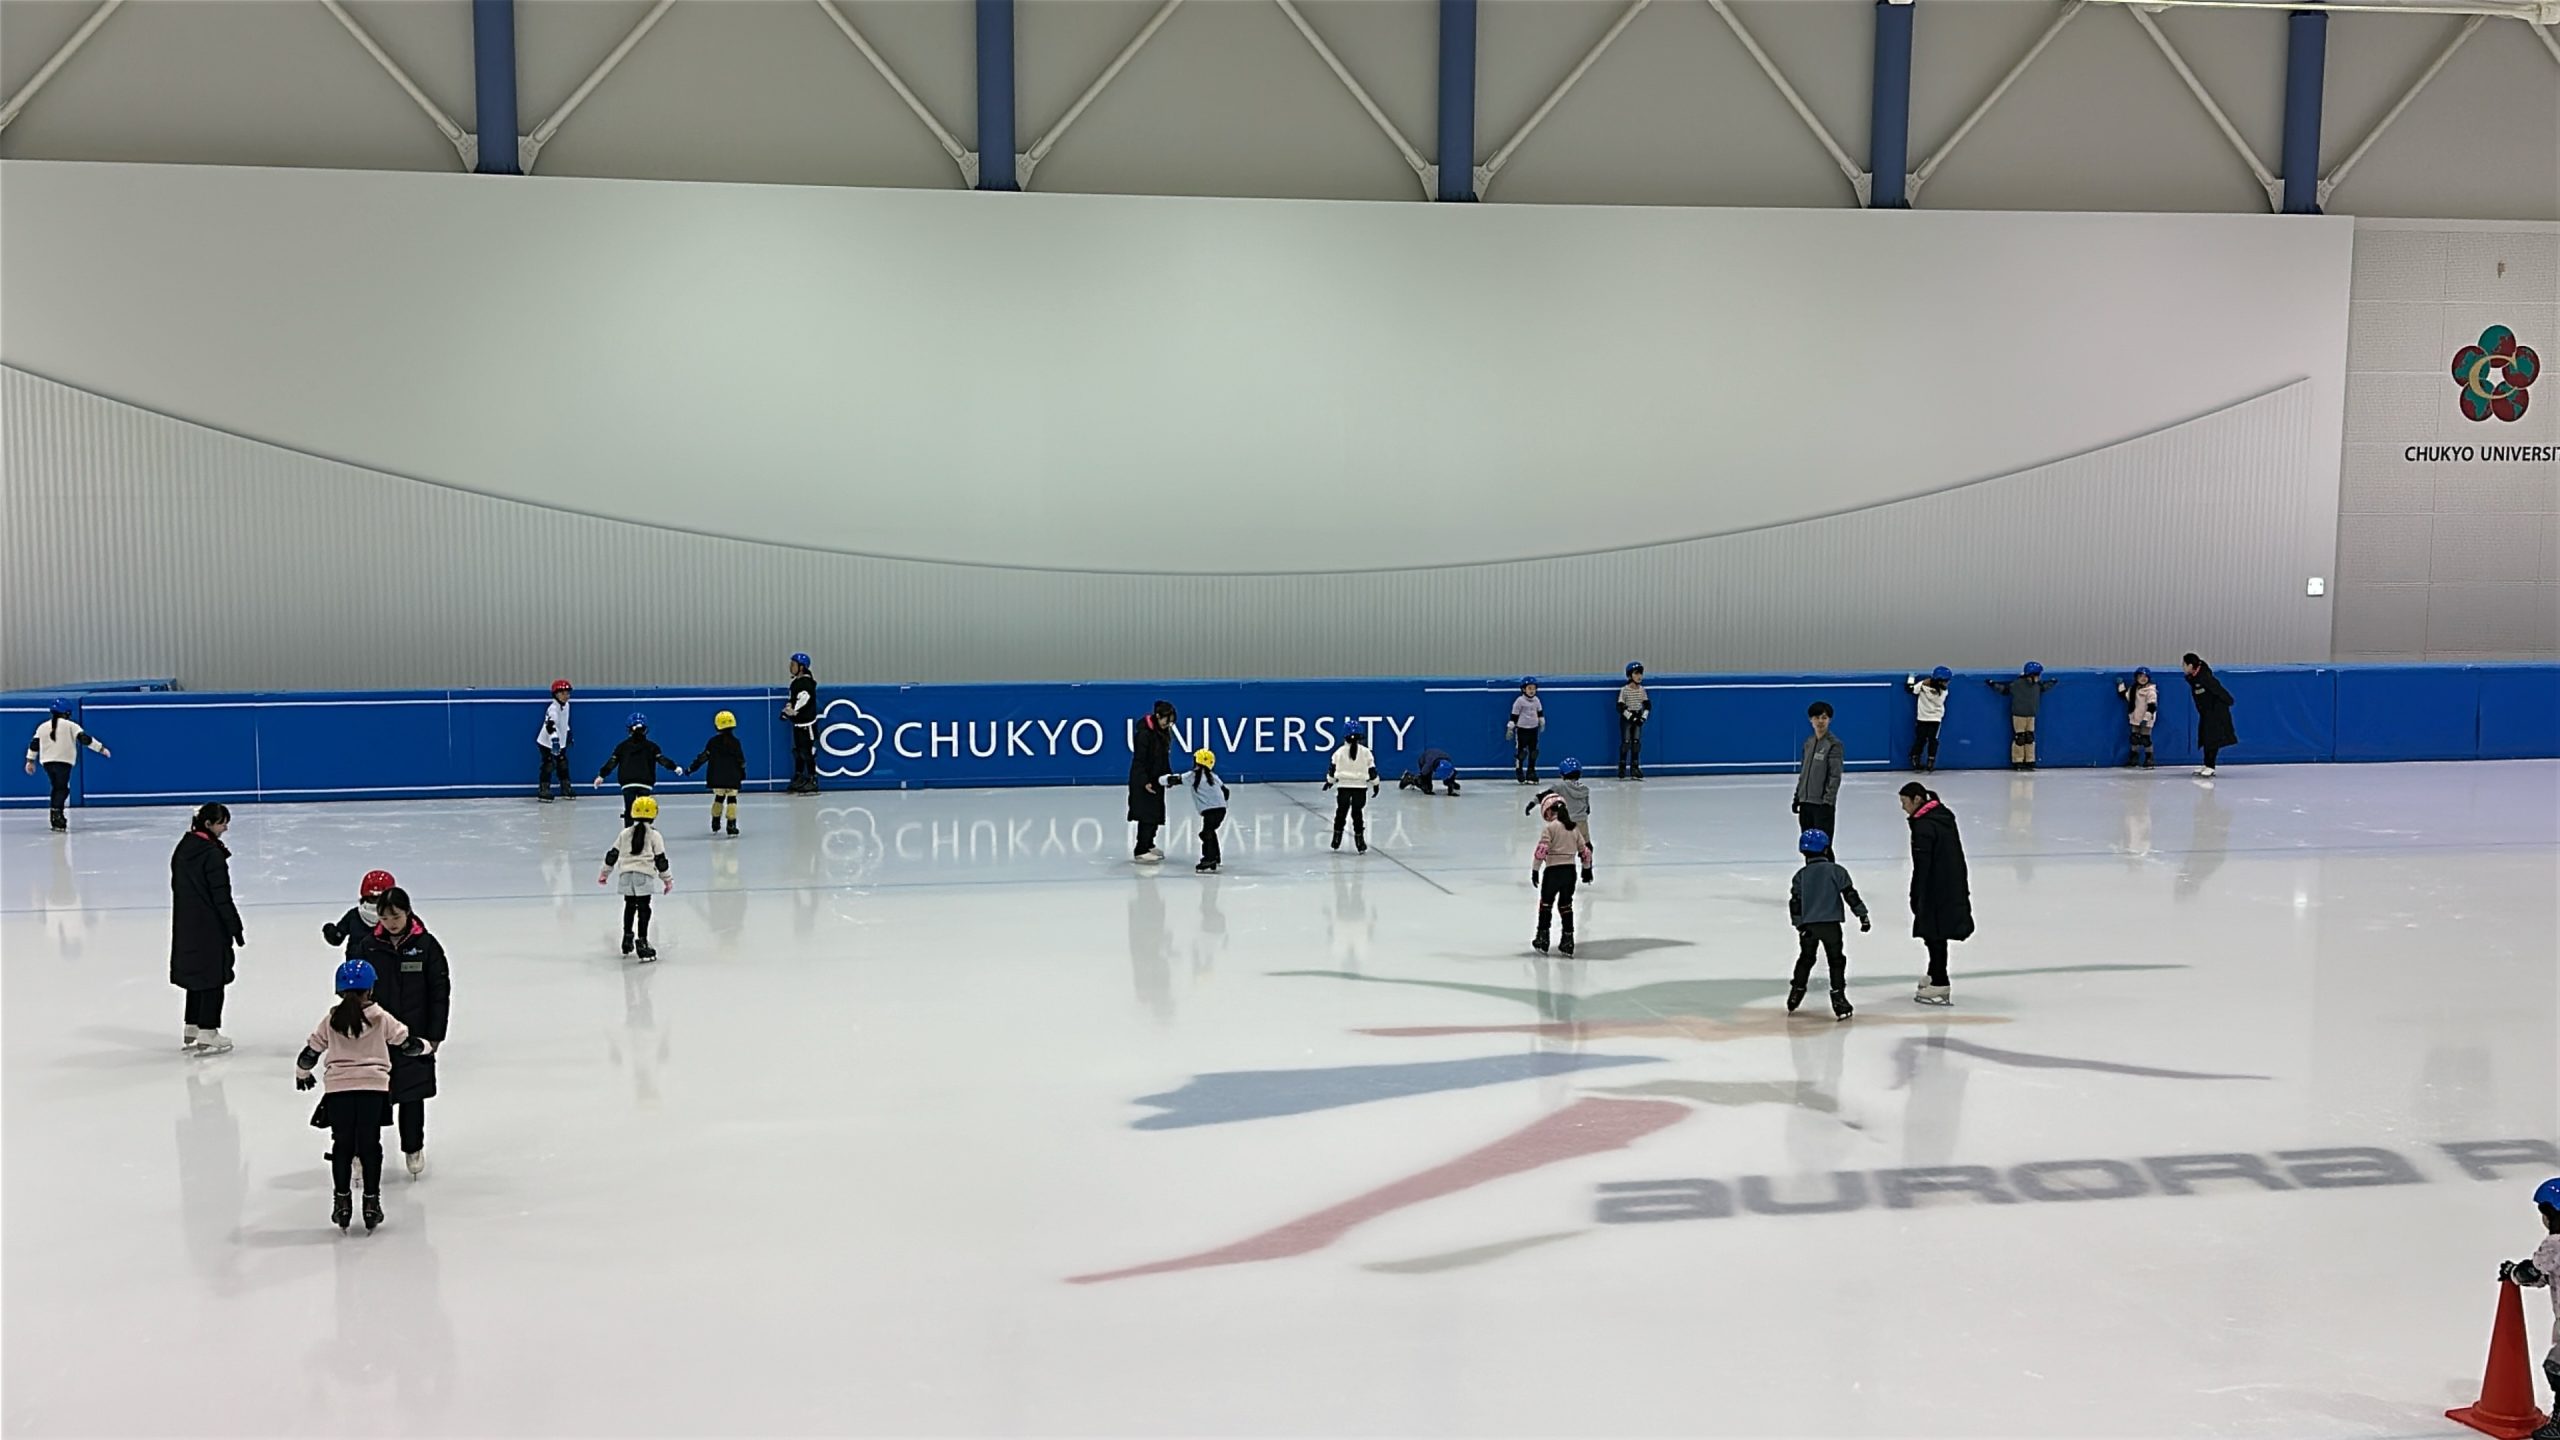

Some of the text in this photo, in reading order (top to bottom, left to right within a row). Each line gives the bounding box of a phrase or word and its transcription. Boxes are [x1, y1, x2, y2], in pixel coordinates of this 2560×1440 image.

[2404, 446, 2475, 462] CHUKYO
[894, 715, 1415, 758] CHUKYO NIVERSTY
